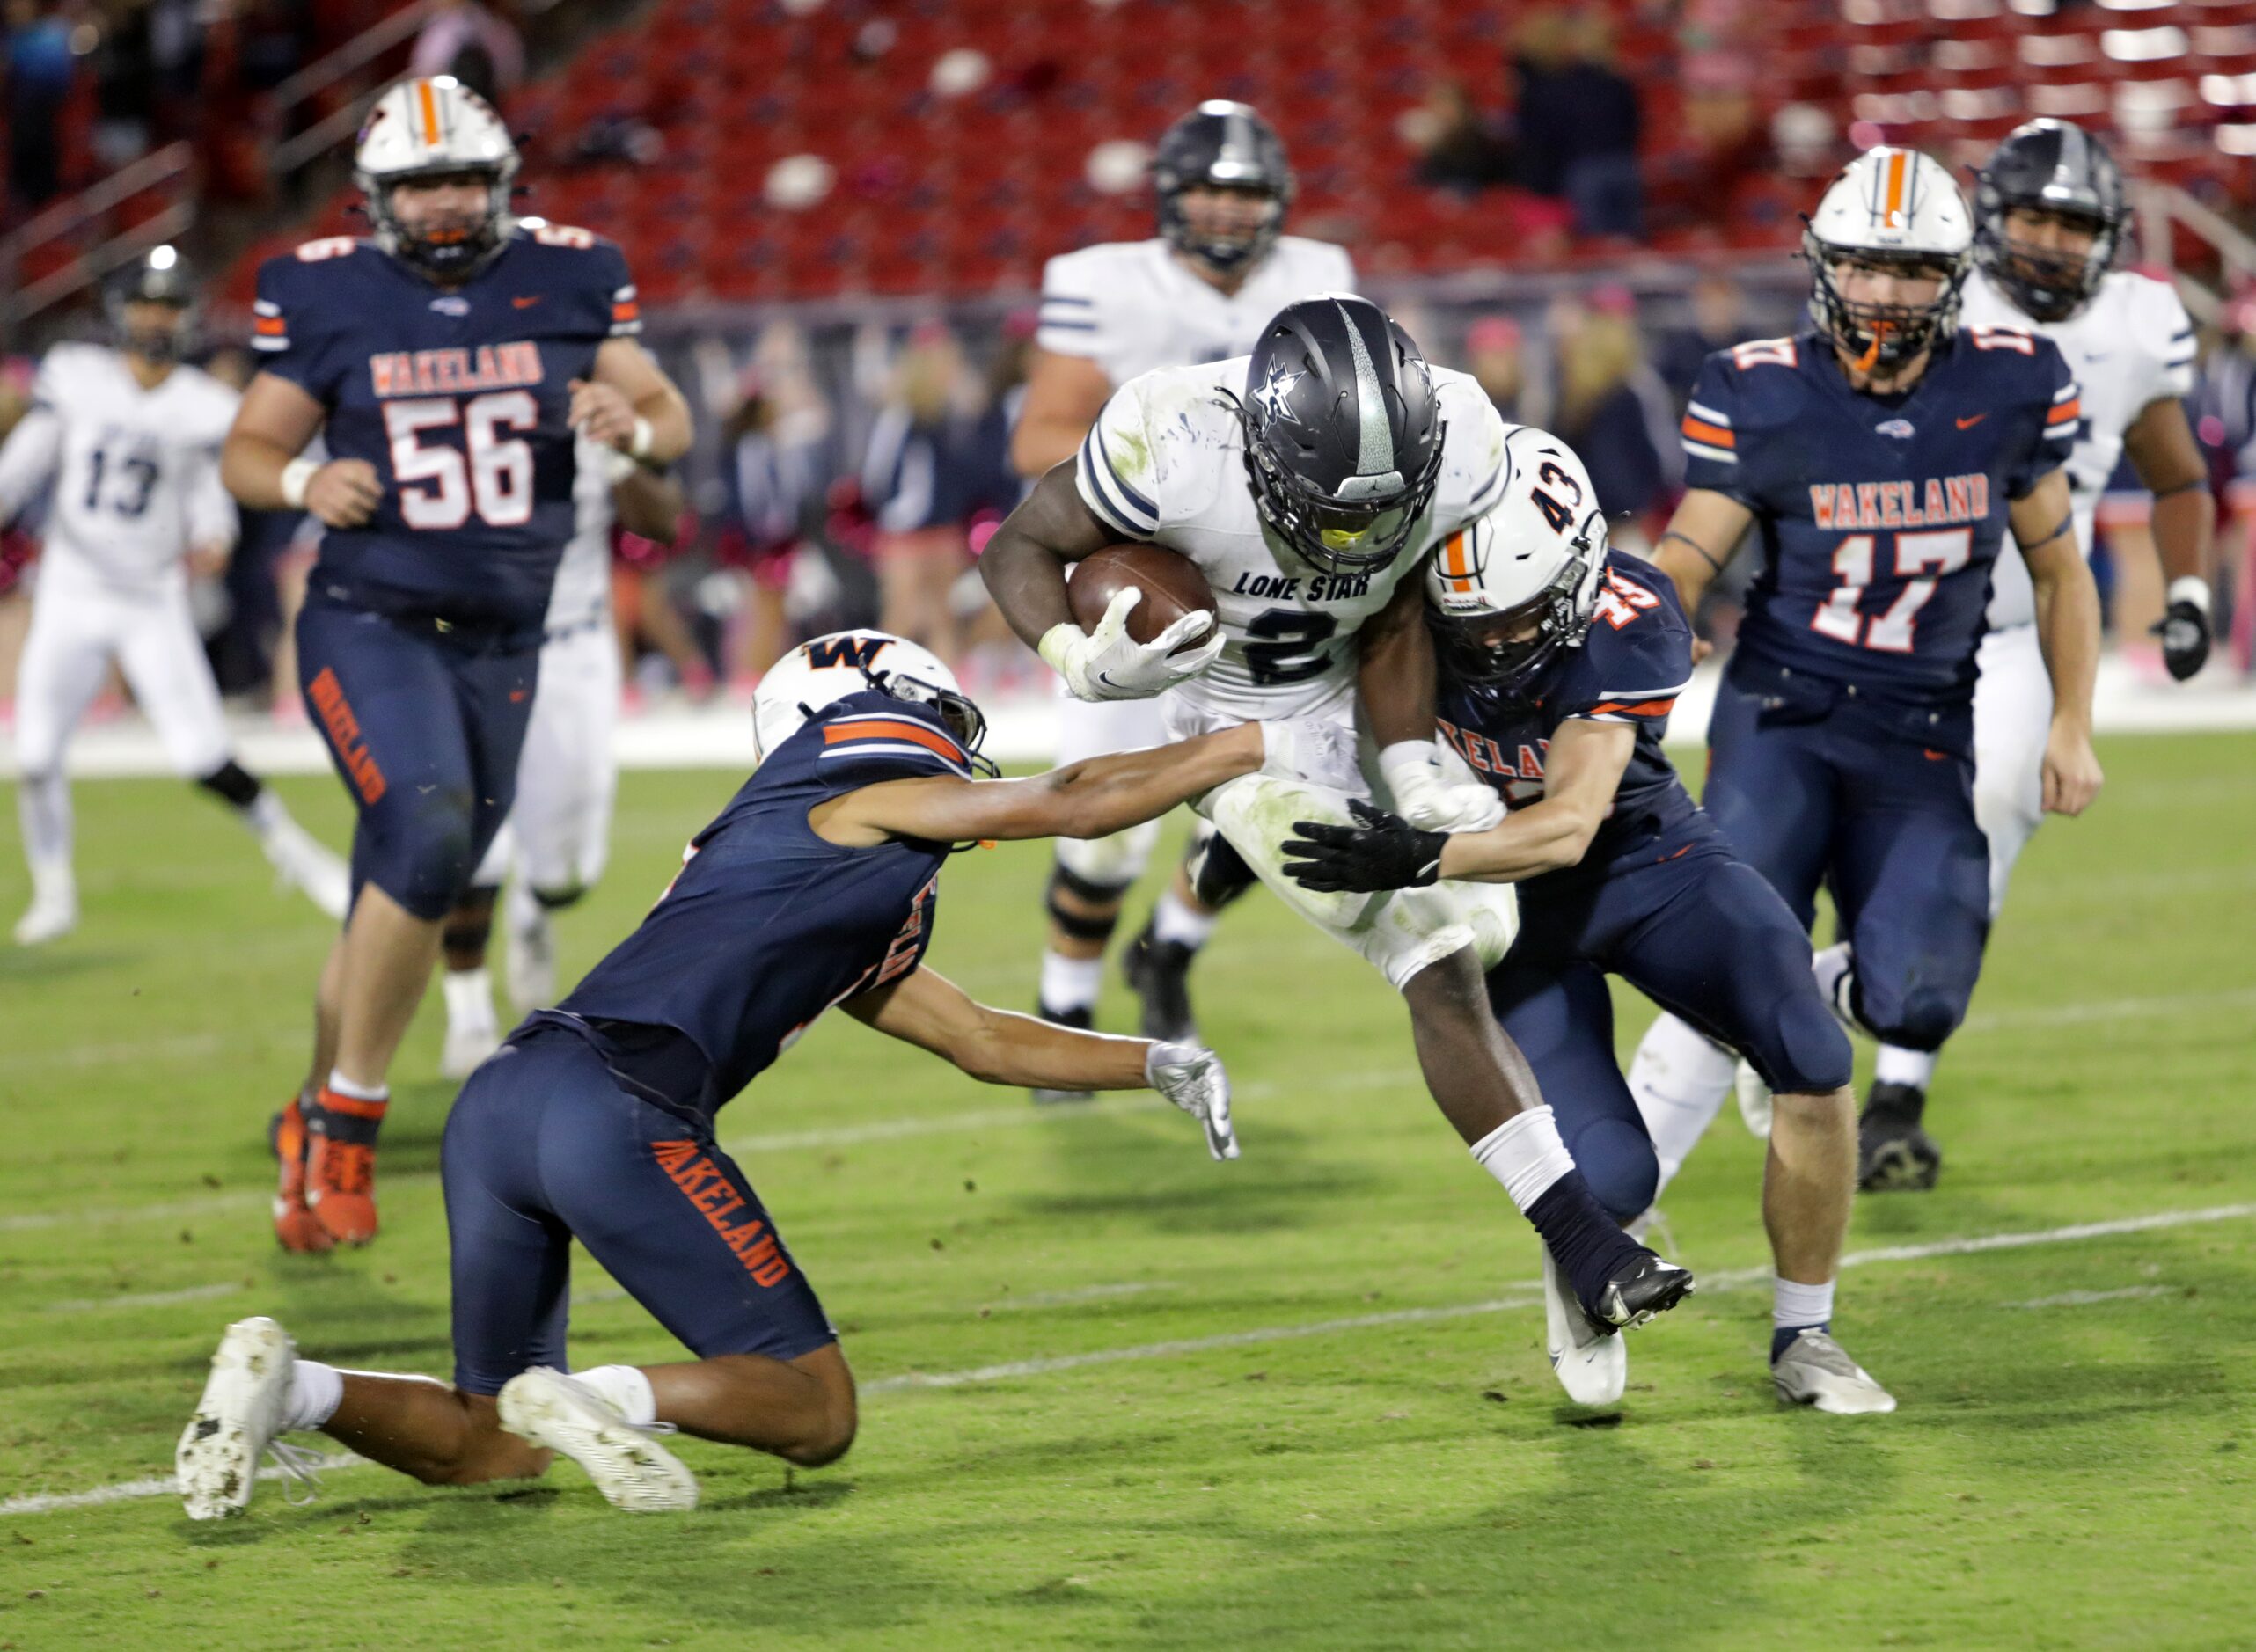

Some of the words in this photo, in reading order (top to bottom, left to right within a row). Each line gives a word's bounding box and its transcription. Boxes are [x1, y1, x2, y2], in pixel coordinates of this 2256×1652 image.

[369, 340, 545, 398] WAKELAND
[84, 450, 162, 521] 13
[381, 389, 539, 530] 56
[1530, 461, 1583, 536] 43
[1809, 472, 1989, 530] WAKELAND
[1234, 572, 1301, 601] LONE
[1307, 572, 1371, 602] STAR
[1810, 526, 1974, 654] 17
[802, 635, 897, 672] W
[1242, 607, 1339, 688] 2
